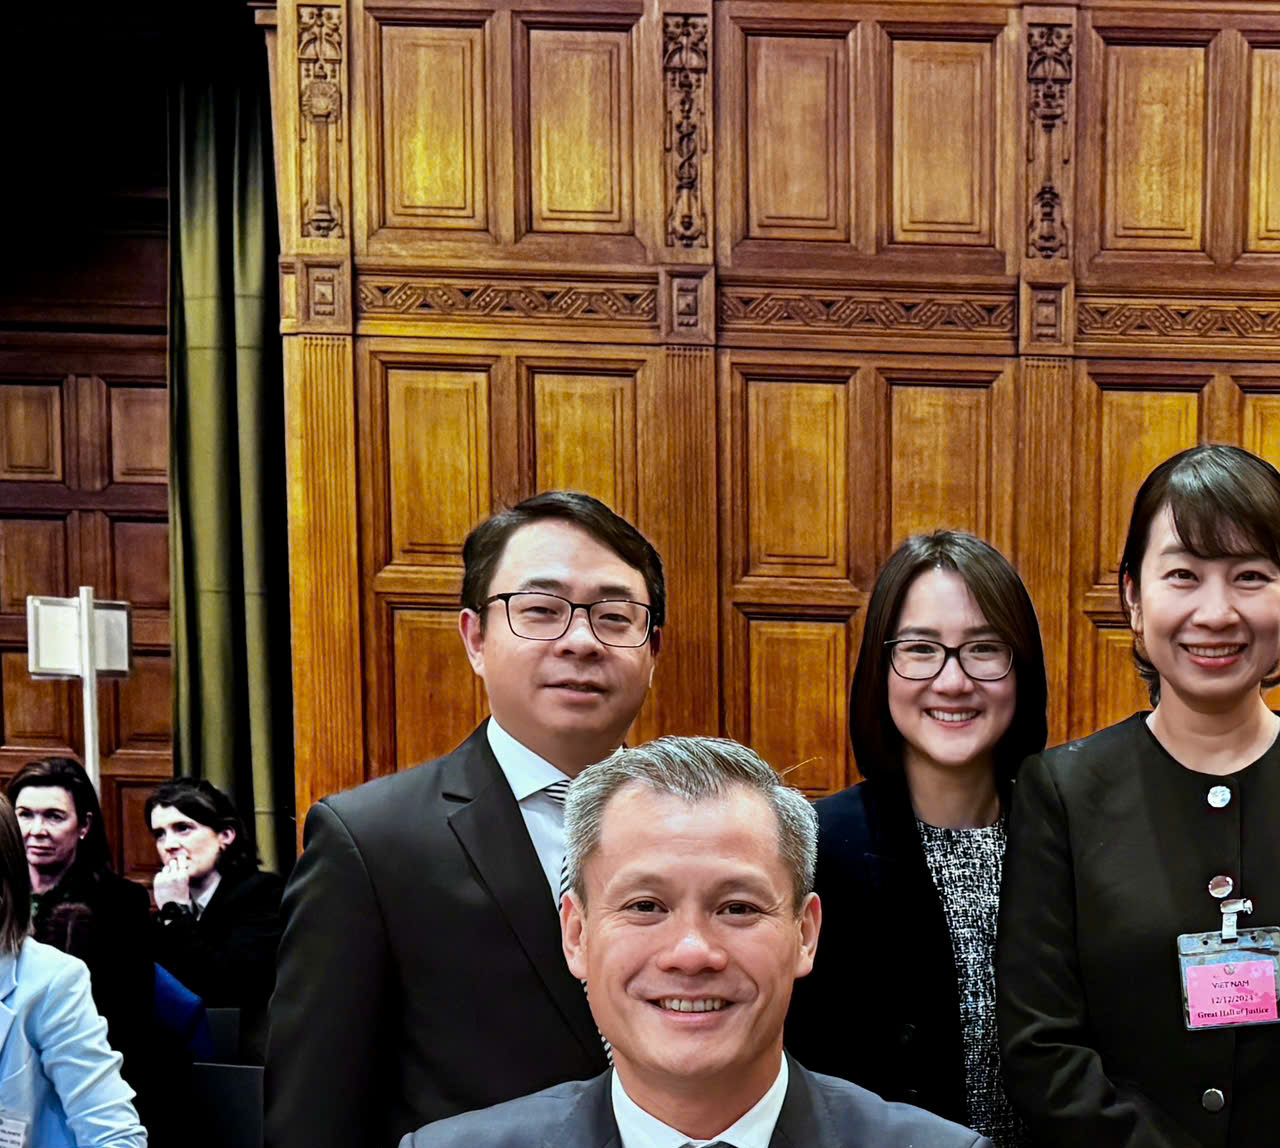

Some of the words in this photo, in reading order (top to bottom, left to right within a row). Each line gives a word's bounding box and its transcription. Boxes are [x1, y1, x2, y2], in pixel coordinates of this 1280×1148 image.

[1211, 995, 1254, 1004] 12/12/2024
[1198, 1010, 1218, 1019] Great
[1220, 1009, 1235, 1017] Hall
[1244, 1007, 1269, 1016] Justice
